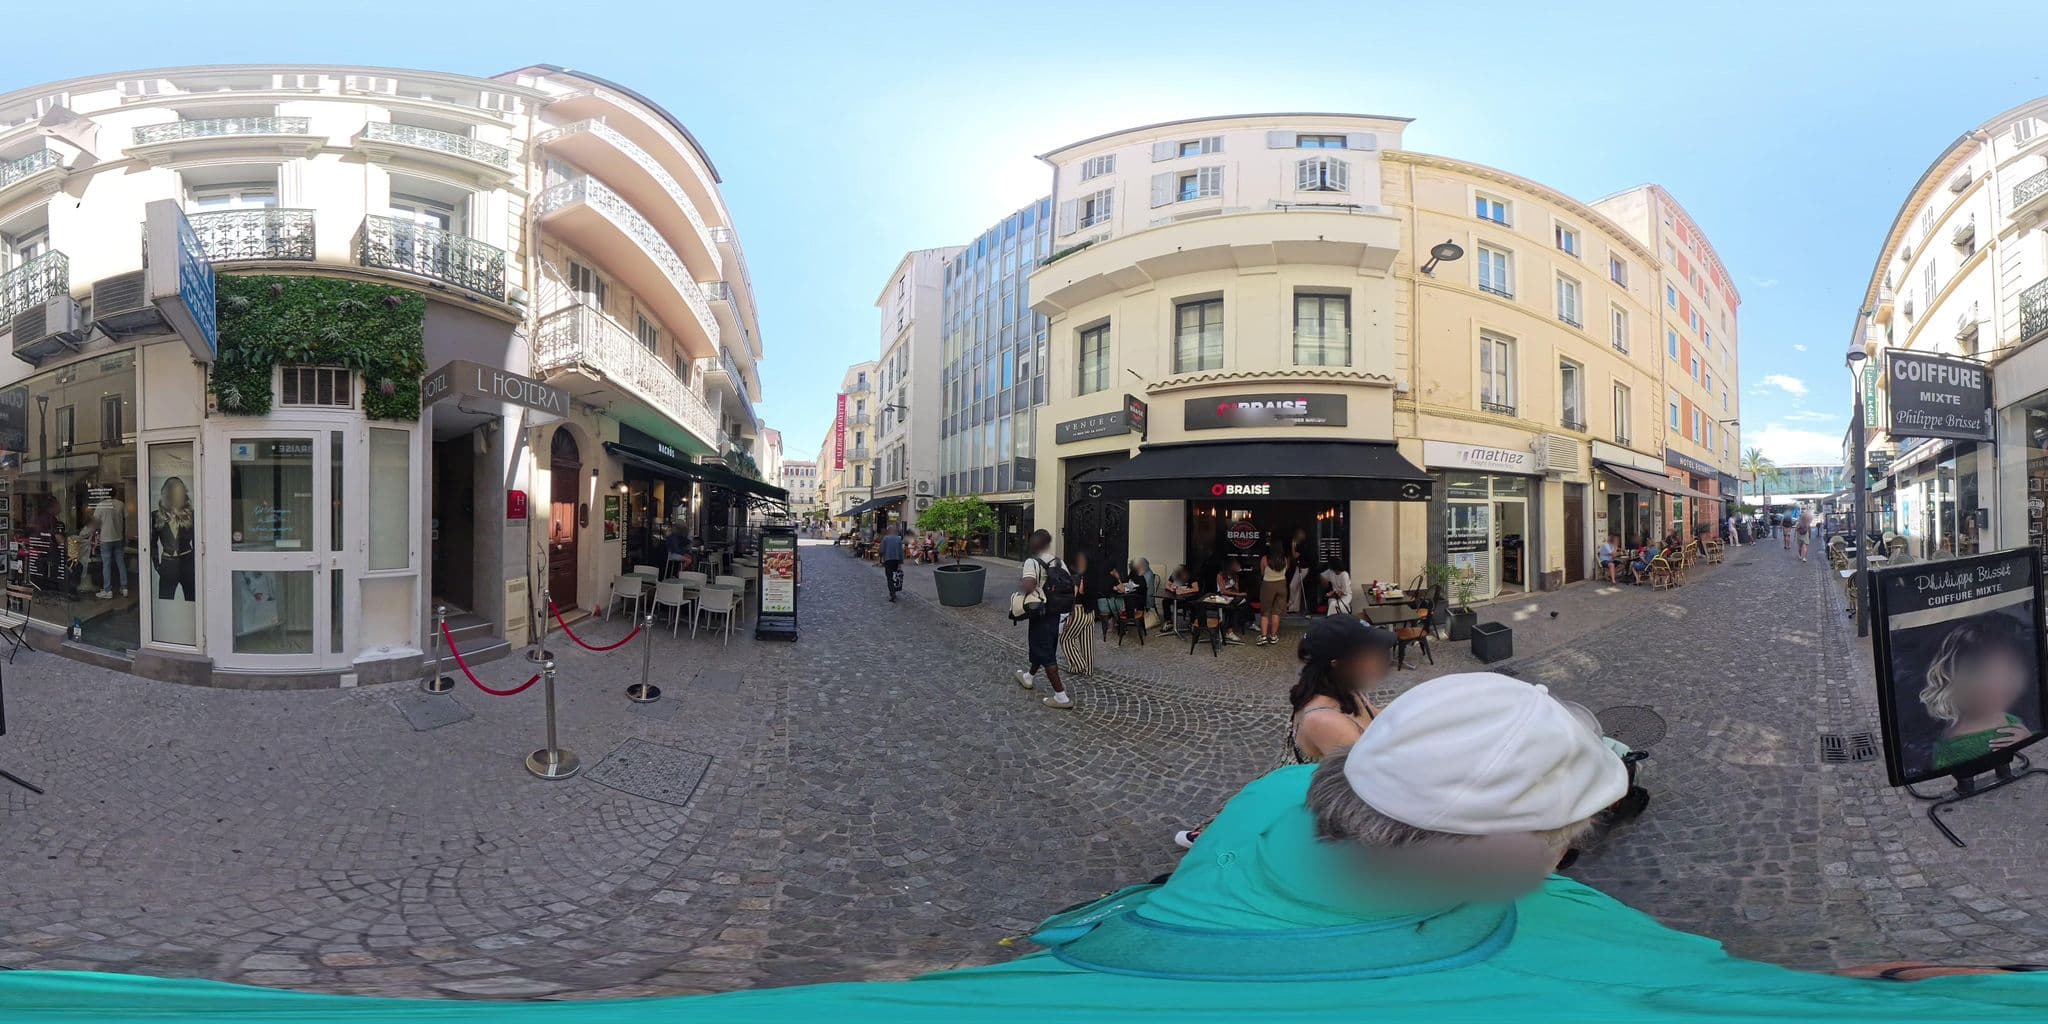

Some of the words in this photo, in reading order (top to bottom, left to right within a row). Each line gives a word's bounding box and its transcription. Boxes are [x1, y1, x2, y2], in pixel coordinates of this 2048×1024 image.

[1895, 360, 1981, 389] COIFFURE
[494, 372, 560, 411] HOTERA
[1920, 391, 1961, 405] MIXTE
[1065, 418, 1104, 431] VENUE
[1896, 409, 1943, 430] Philippe
[1945, 414, 1981, 430] Brisset
[1471, 448, 1523, 464] mathez
[1914, 571, 1973, 593] Philippe
[1976, 563, 2011, 582] Brisset
[1928, 591, 1973, 606] COIFFURE
[1976, 584, 2002, 597] MIXTE
